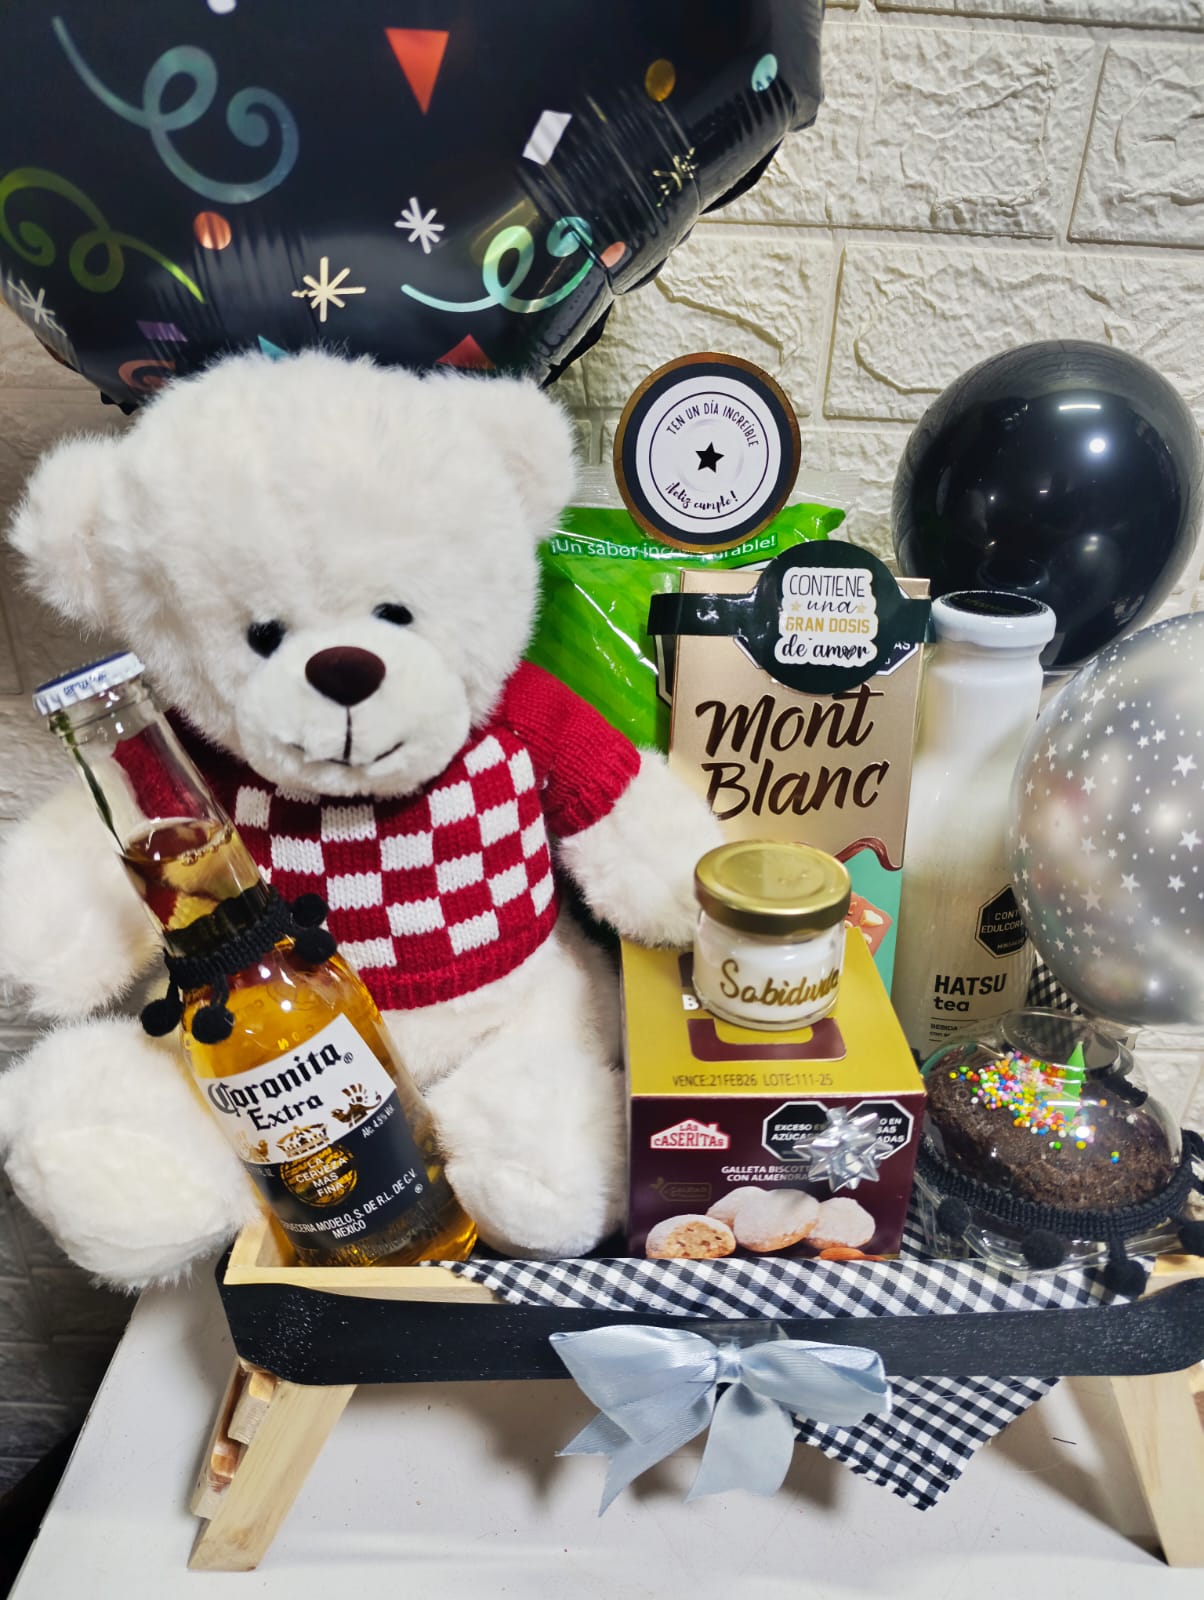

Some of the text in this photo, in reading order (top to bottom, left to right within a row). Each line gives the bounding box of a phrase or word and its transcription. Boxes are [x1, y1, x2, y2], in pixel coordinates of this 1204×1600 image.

[666, 399, 760, 447] TEN UN DÍA INCREÍBLE
[587, 540, 639, 558] sabor
[789, 574, 865, 597] CONTIENE
[807, 600, 857, 614] una
[785, 616, 870, 634] GRAN DOSIS
[782, 633, 807, 657] de
[695, 683, 885, 764] Mont
[700, 758, 890, 821] Blanc
[934, 973, 1007, 996] HATSU
[933, 996, 969, 1012] tea
[207, 1043, 343, 1118] Coronita
[247, 1095, 323, 1131] Extra
[774, 1124, 812, 1132] EXCESO
[295, 1156, 348, 1183] CERVEZA
[307, 1157, 324, 1169] LA
[721, 1165, 810, 1174] GALLETA BISCOTT
[312, 1172, 339, 1189] MAS
[727, 1174, 749, 1182] CON
[317, 1182, 345, 1198] FINA
[363, 1200, 378, 1214] DE
[392, 1179, 405, 1194] DE
